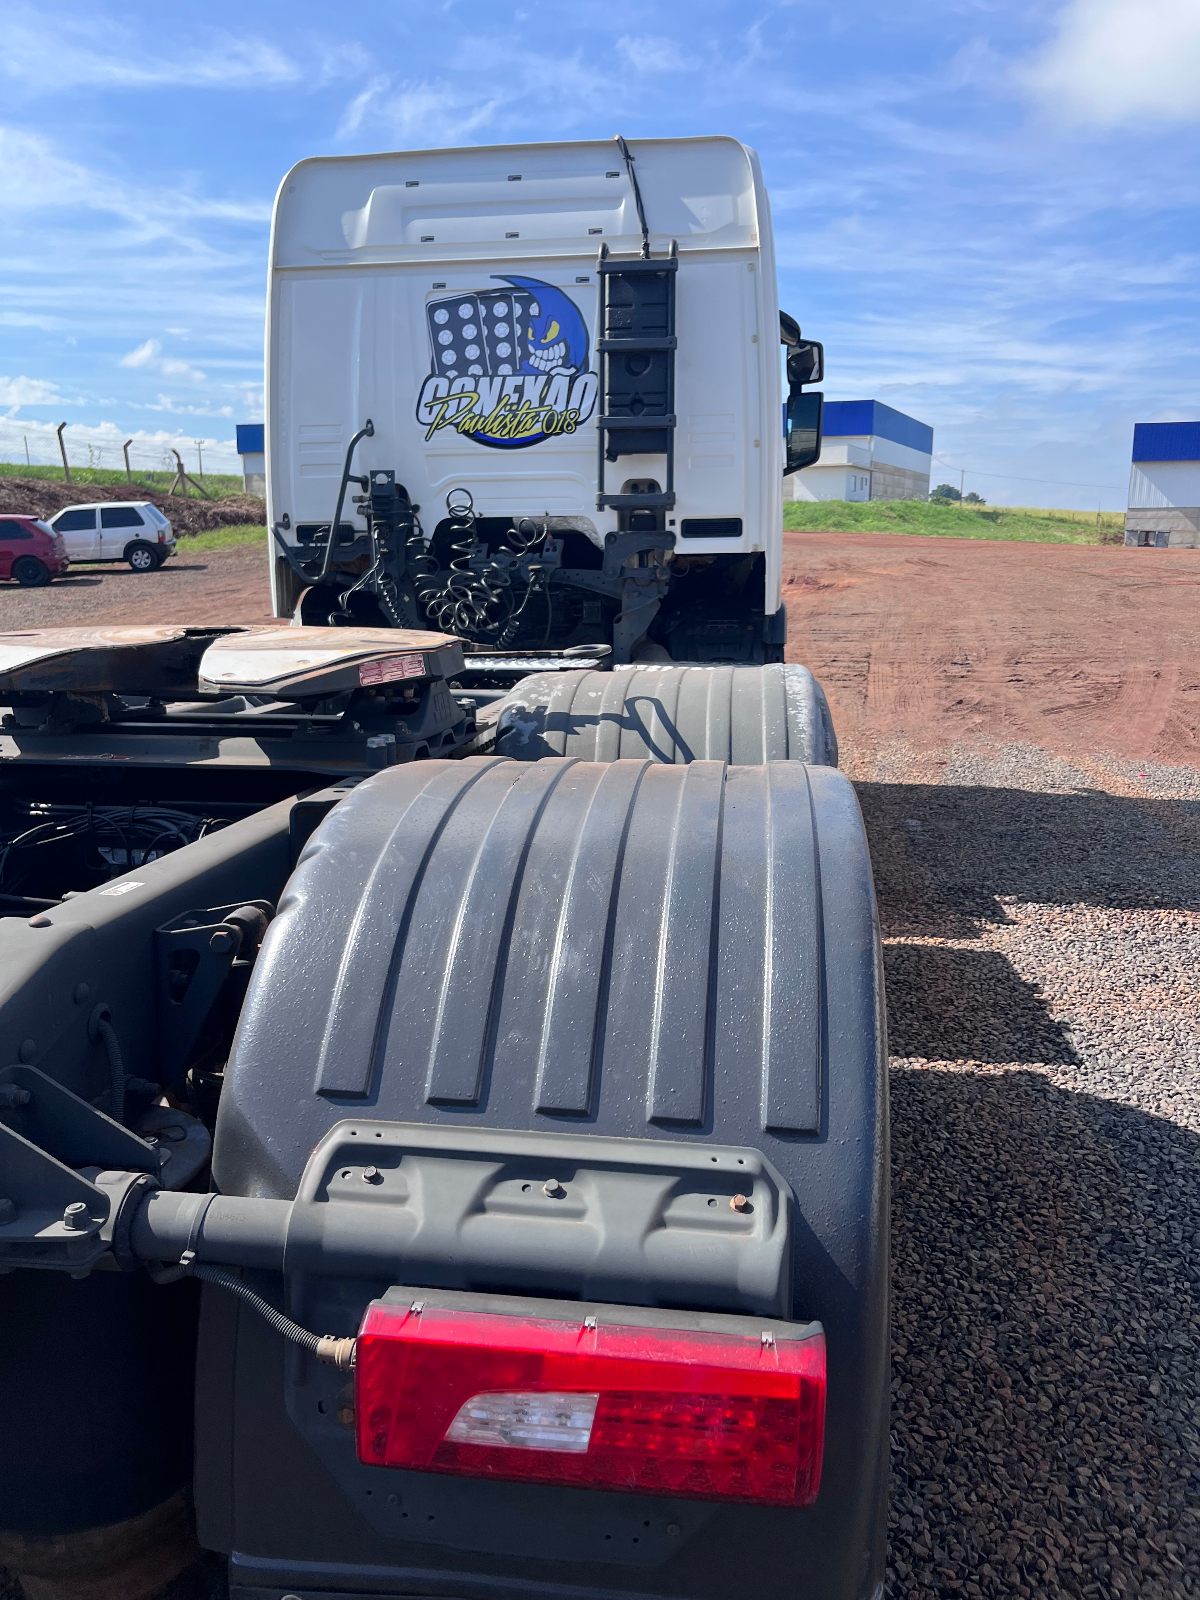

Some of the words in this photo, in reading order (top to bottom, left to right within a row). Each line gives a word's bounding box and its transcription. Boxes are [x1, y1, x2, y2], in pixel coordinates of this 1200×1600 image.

[416, 366, 598, 427] CONEXÃO
[424, 391, 553, 442] Paulista
[541, 408, 580, 435] 018
